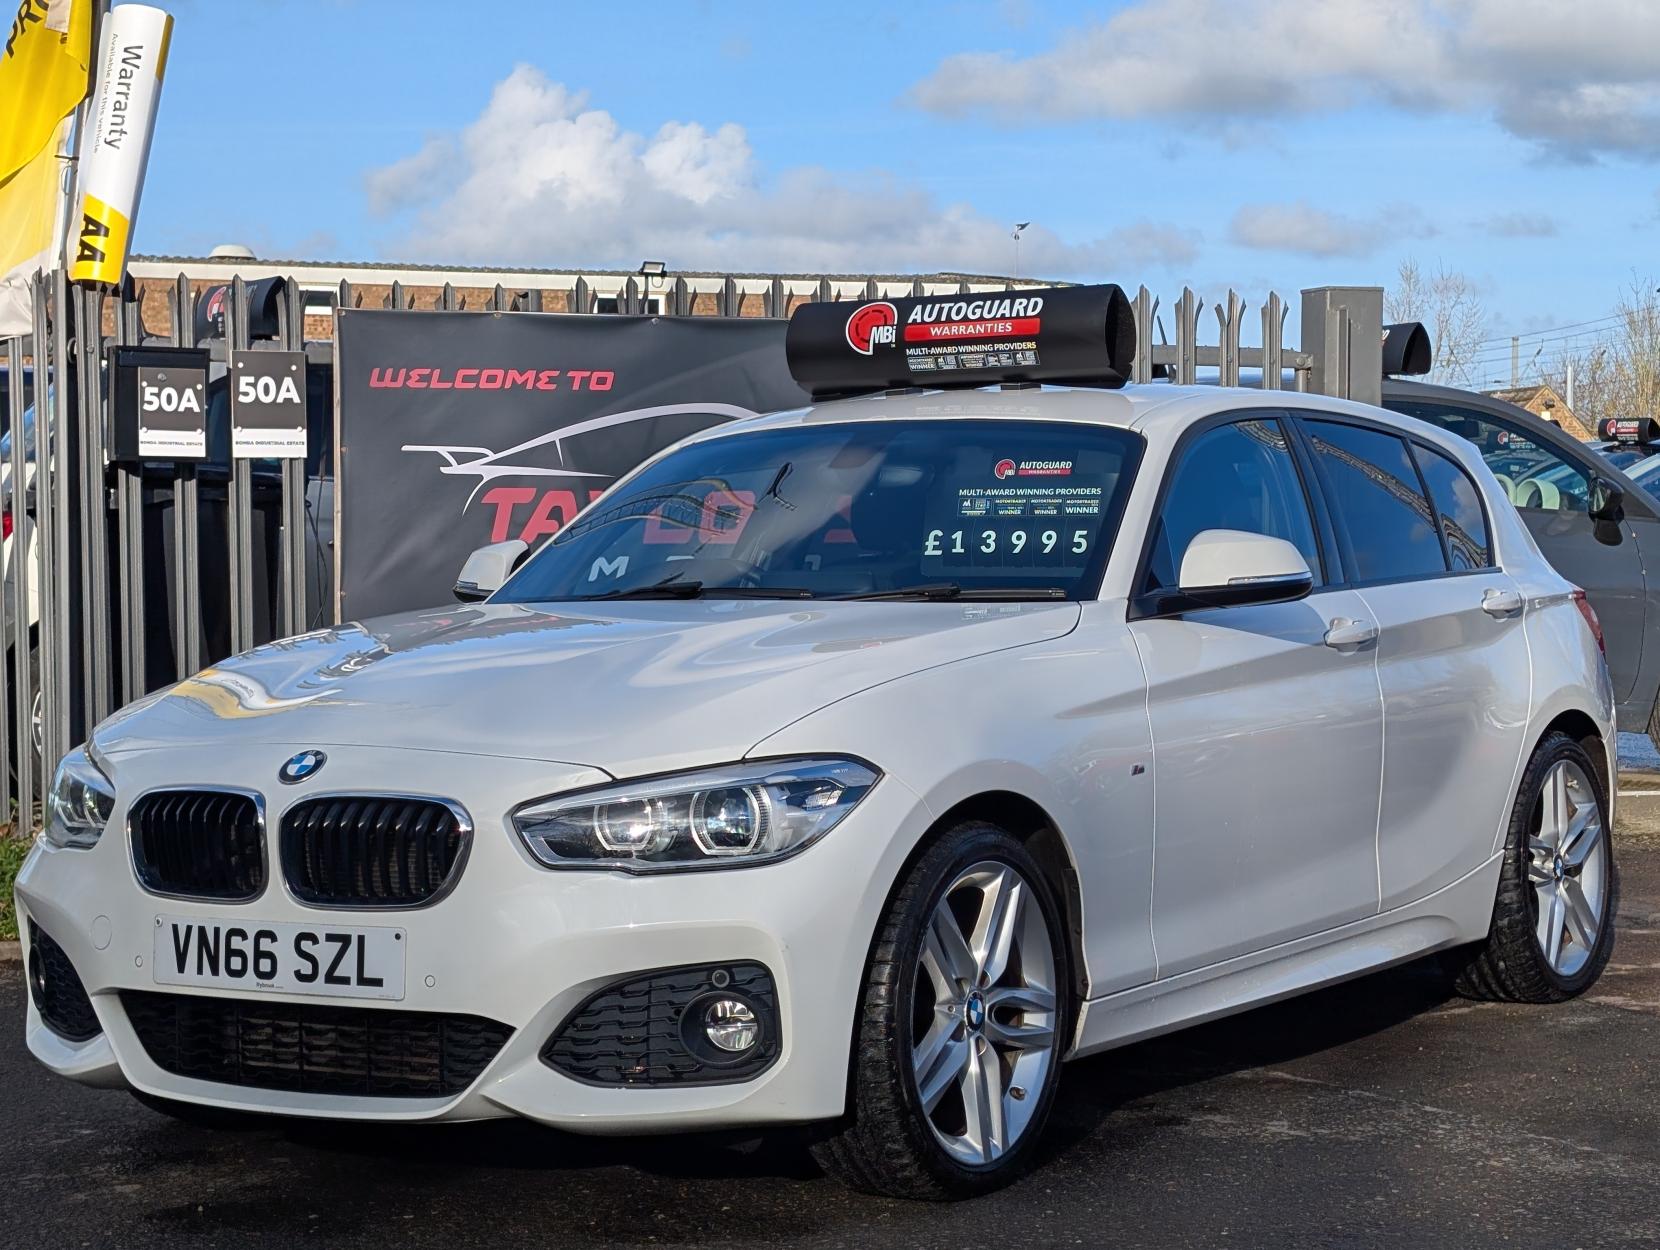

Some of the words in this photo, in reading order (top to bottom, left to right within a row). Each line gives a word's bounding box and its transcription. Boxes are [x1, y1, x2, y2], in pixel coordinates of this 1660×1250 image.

[104, 45, 144, 150] Warranty
[76, 212, 110, 263] AA
[907, 297, 1044, 324] AUTOGUARD
[930, 322, 1013, 337] WARRANTIES
[906, 346, 958, 356] MULTI-AWARD
[958, 343, 993, 353] WINNING
[994, 341, 1037, 351] PROVIDERS
[237, 376, 301, 404] 50A
[369, 367, 561, 391] WELCOME
[567, 370, 615, 392] TO
[142, 387, 200, 413] 50A
[1019, 461, 1073, 470] AUTOGUARD
[959, 488, 1016, 497] MULTI-AWARD
[1016, 488, 1055, 496] WINNING
[1055, 487, 1102, 496] PROVIDERS
[1065, 506, 1099, 514] WINNER
[171, 923, 278, 980] VN66
[293, 931, 384, 988] SZL
